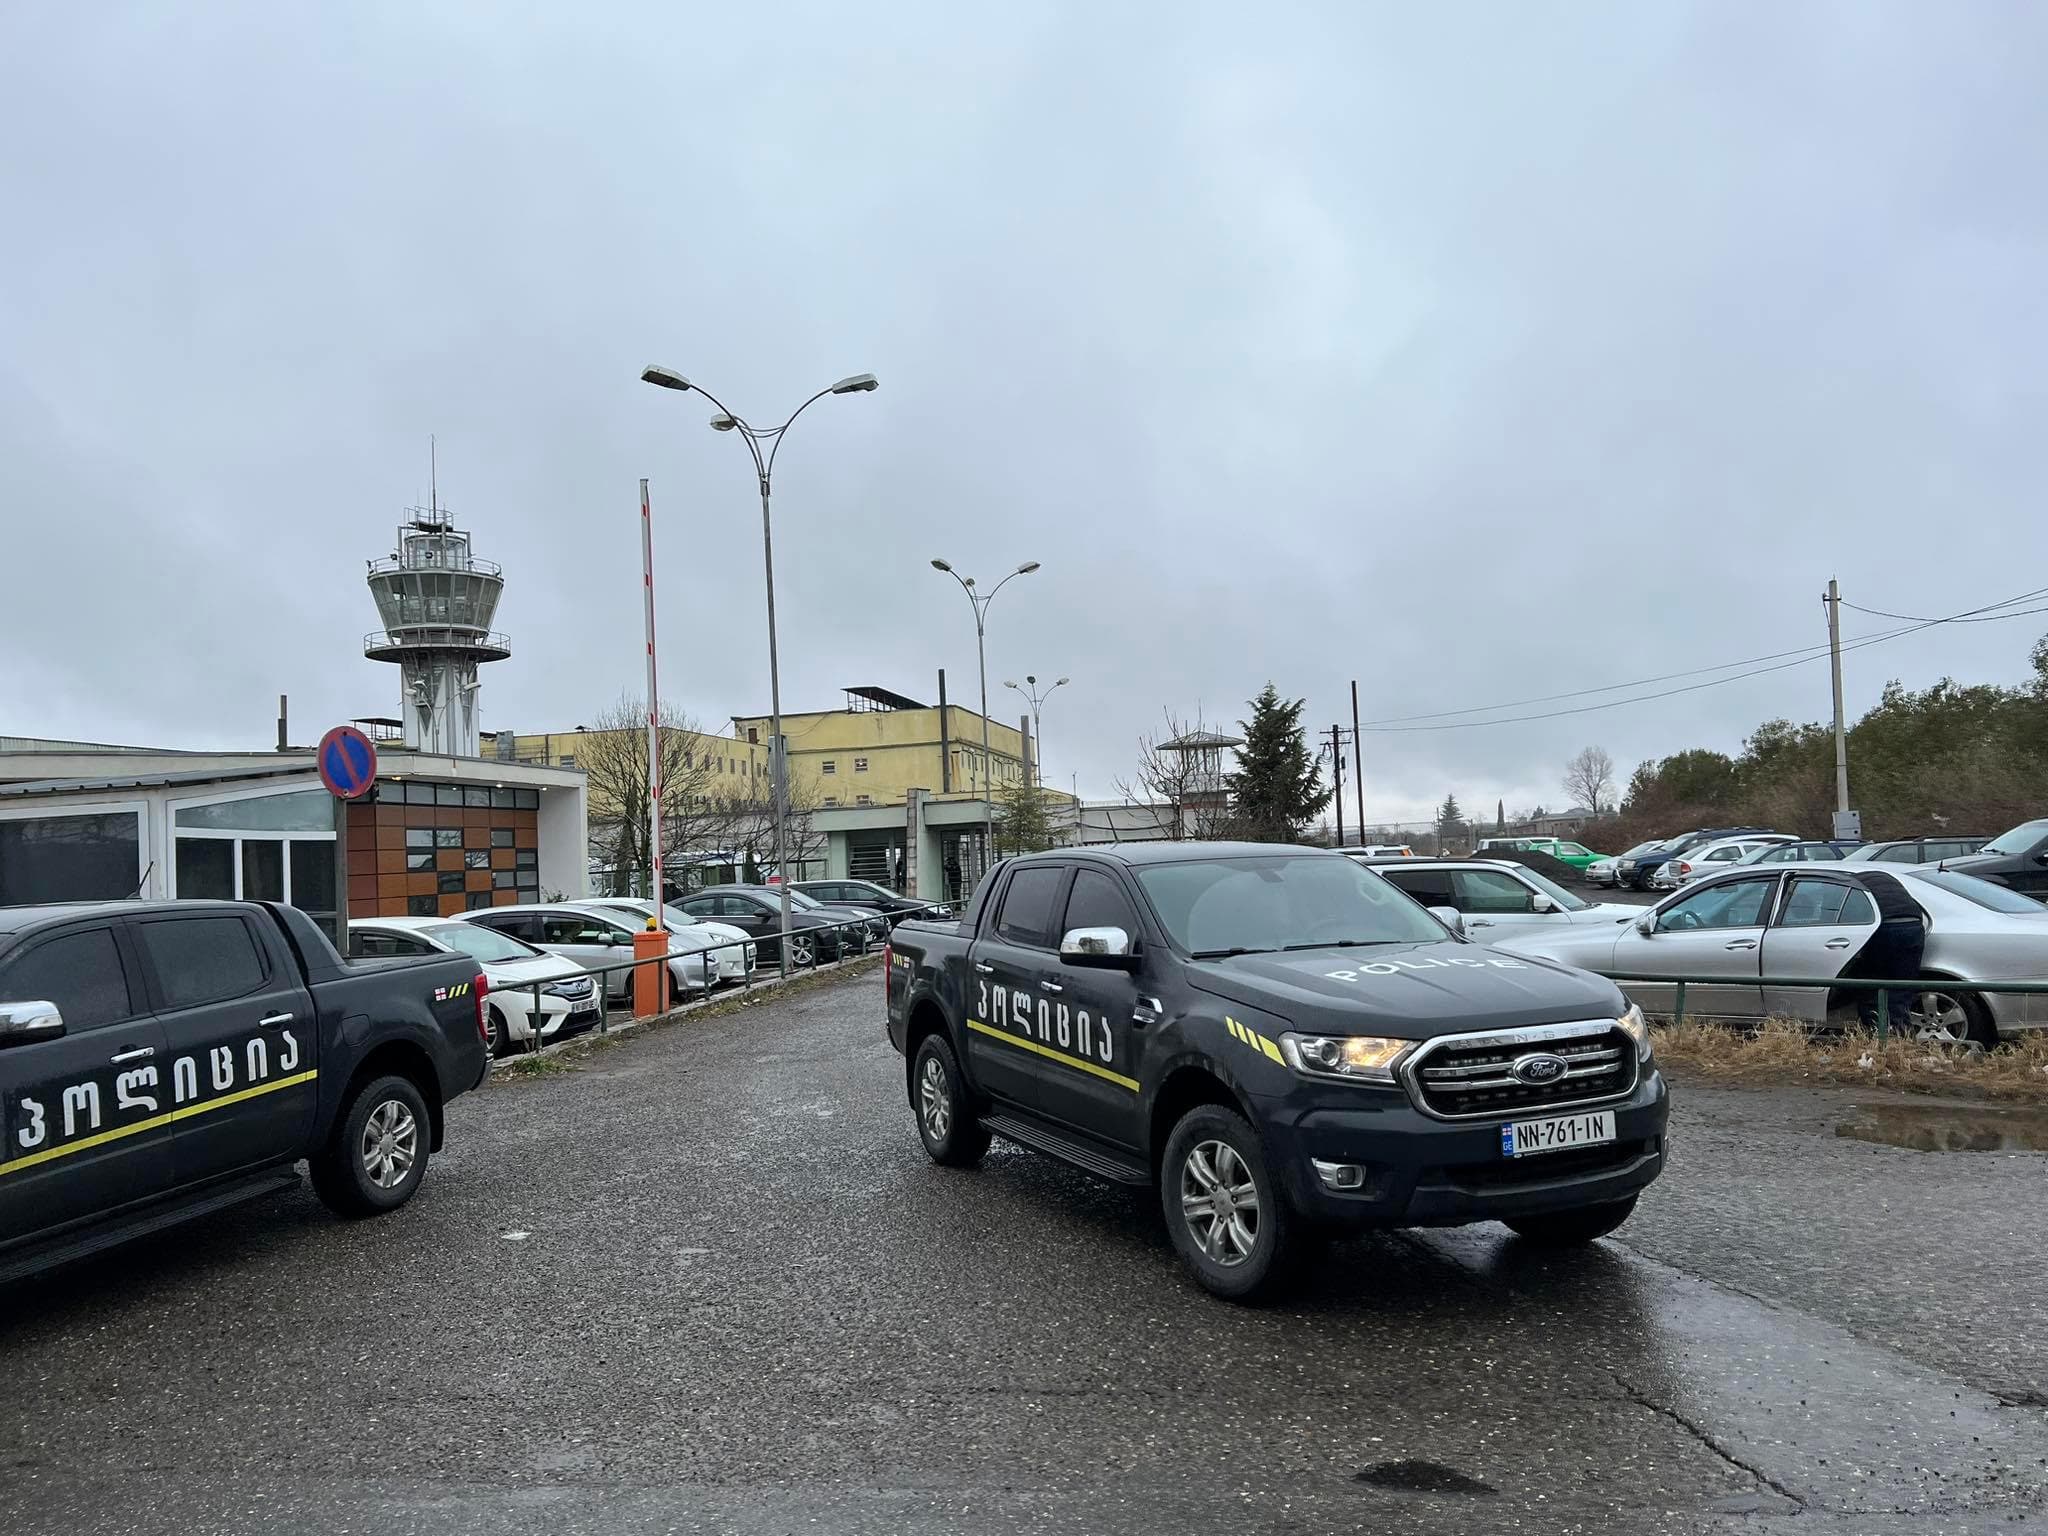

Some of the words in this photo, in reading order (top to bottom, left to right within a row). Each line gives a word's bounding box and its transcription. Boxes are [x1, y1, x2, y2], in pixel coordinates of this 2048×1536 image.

[1325, 958, 1528, 982] POLICE
[977, 980, 1113, 1063] პოლიცია
[1530, 1061, 1558, 1078] Ford
[18, 1030, 299, 1148] პოლიცია
[1503, 1141, 1513, 1151] GE
[1517, 1116, 1604, 1149] NN-761-IN
